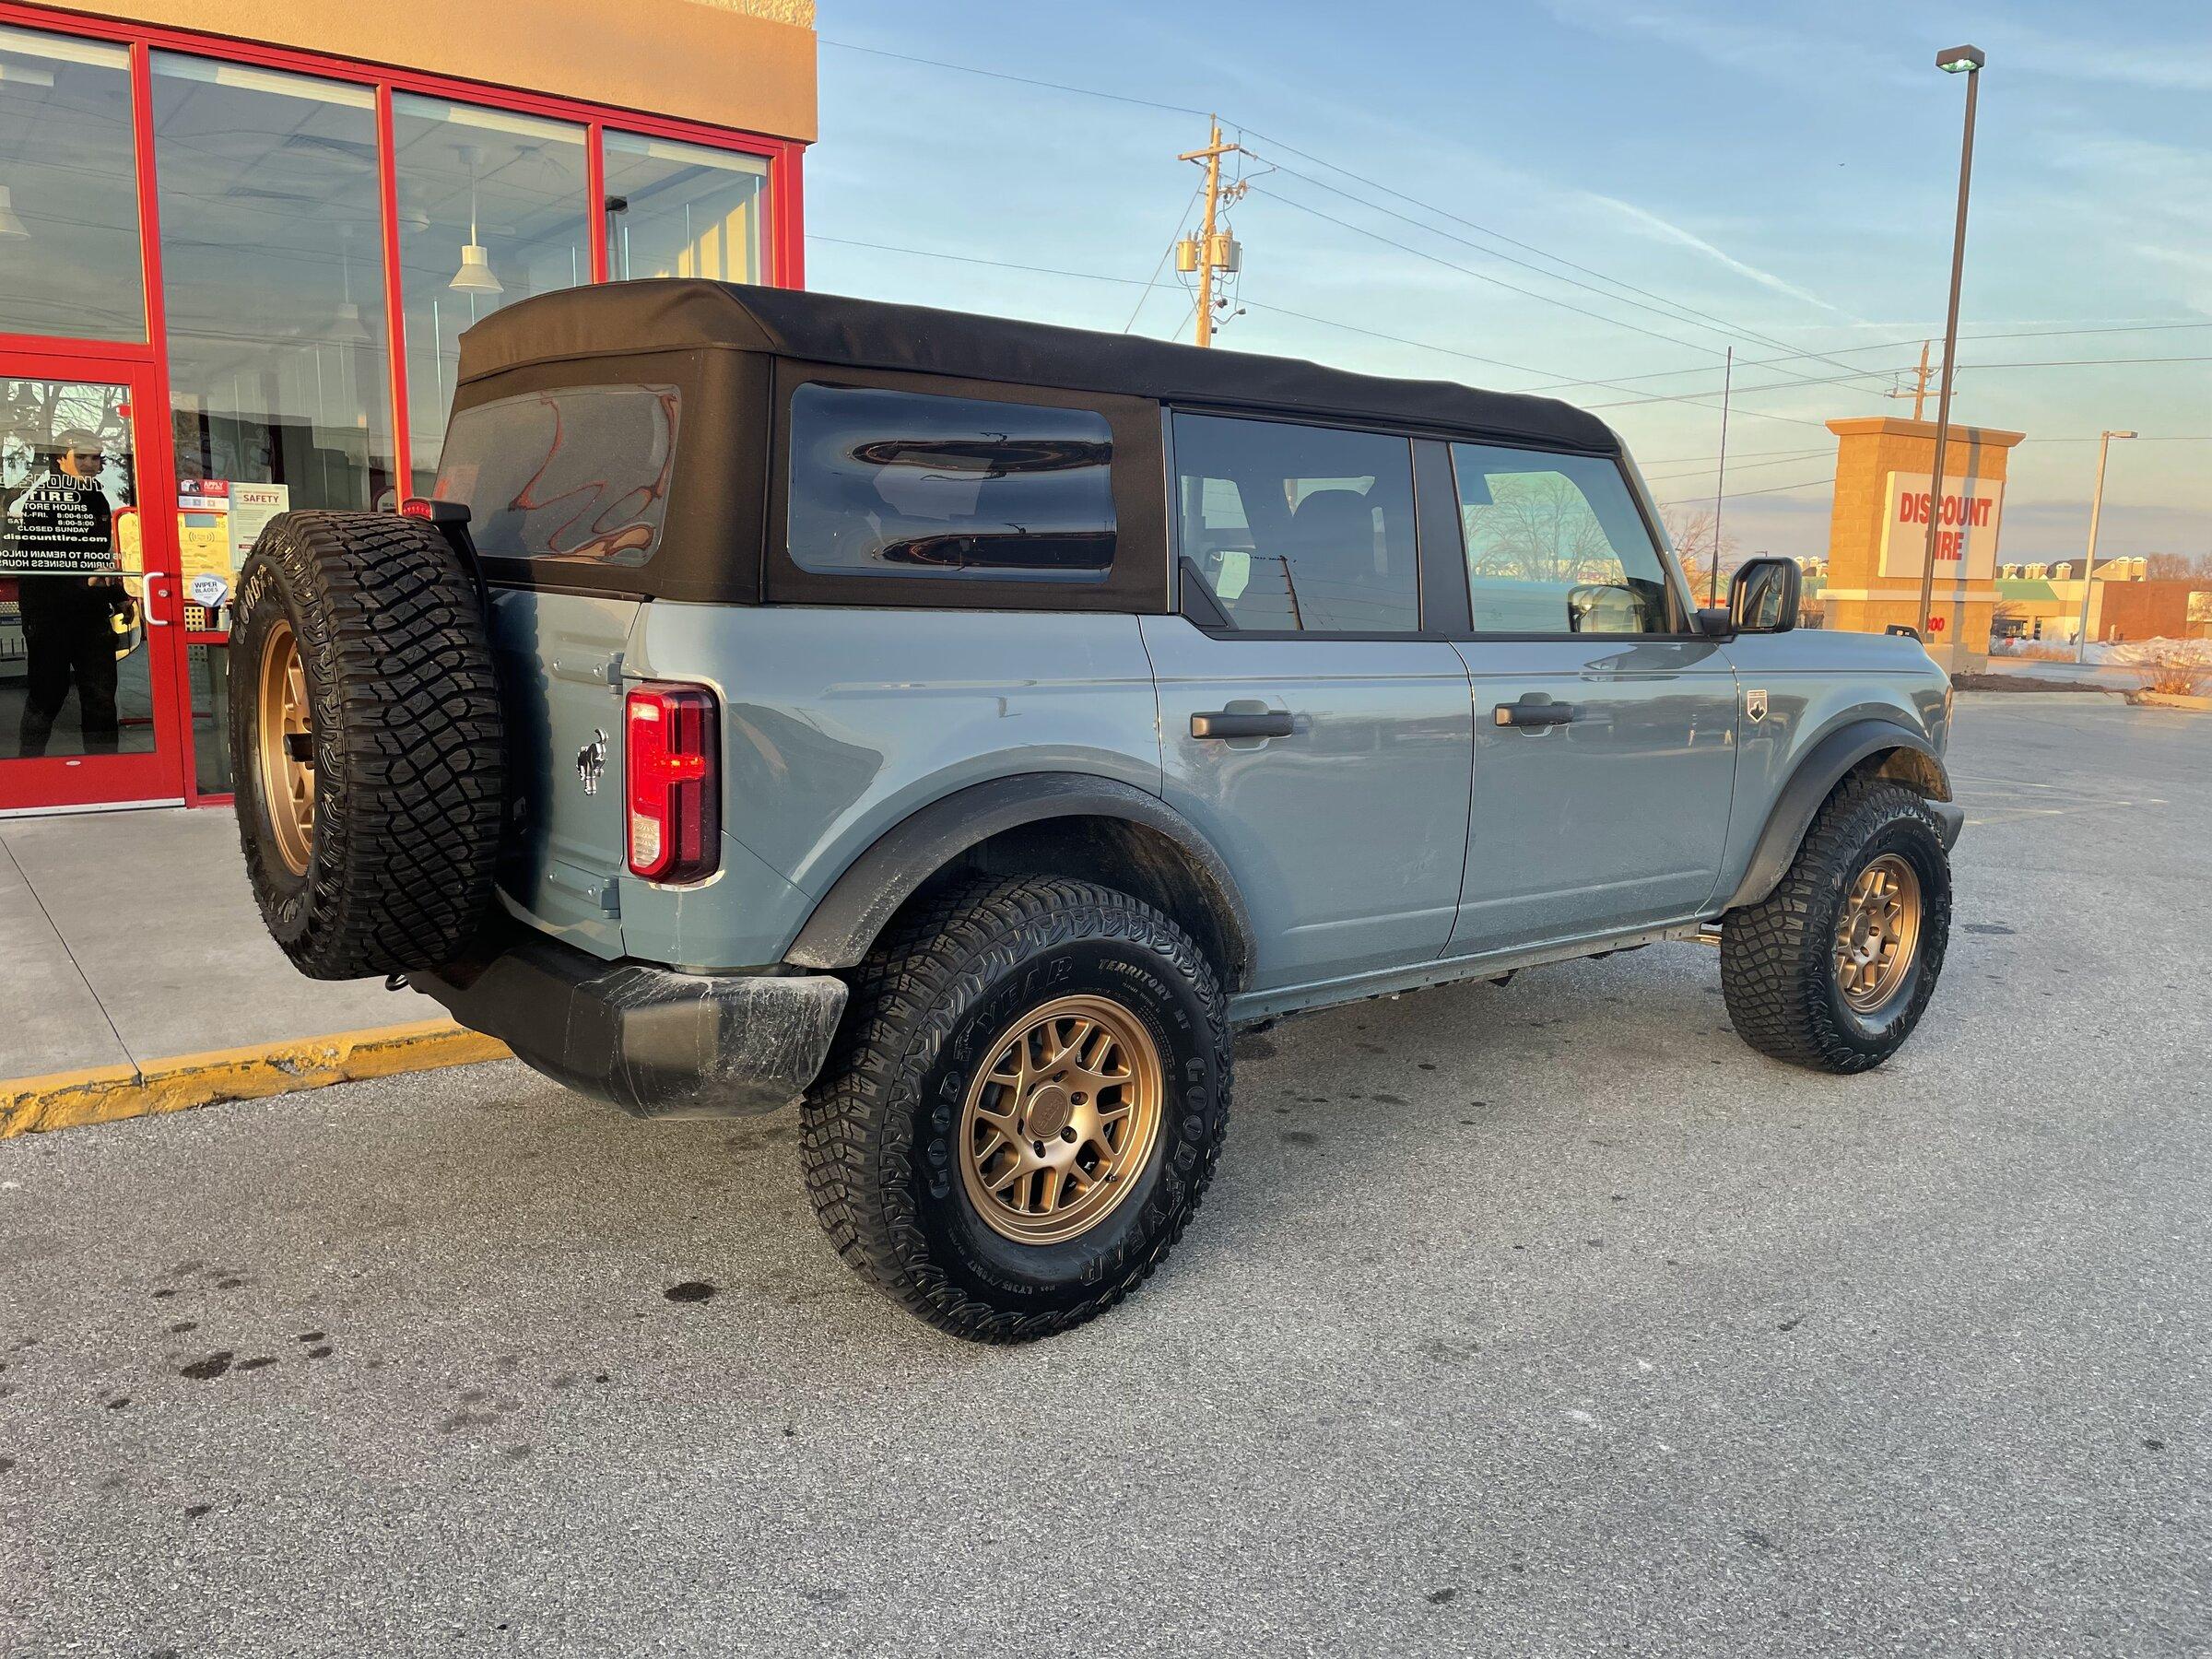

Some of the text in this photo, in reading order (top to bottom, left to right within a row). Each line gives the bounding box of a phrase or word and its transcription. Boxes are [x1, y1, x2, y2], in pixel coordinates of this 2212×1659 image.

[29, 491, 75, 502] TIRE
[243, 494, 279, 503] SAFETY
[22, 502, 88, 512] TORE HOURS
[3, 534, 108, 543] discounttire.com
[1924, 531, 1964, 560] IRE
[1098, 959, 1173, 1002] TERRITORY
